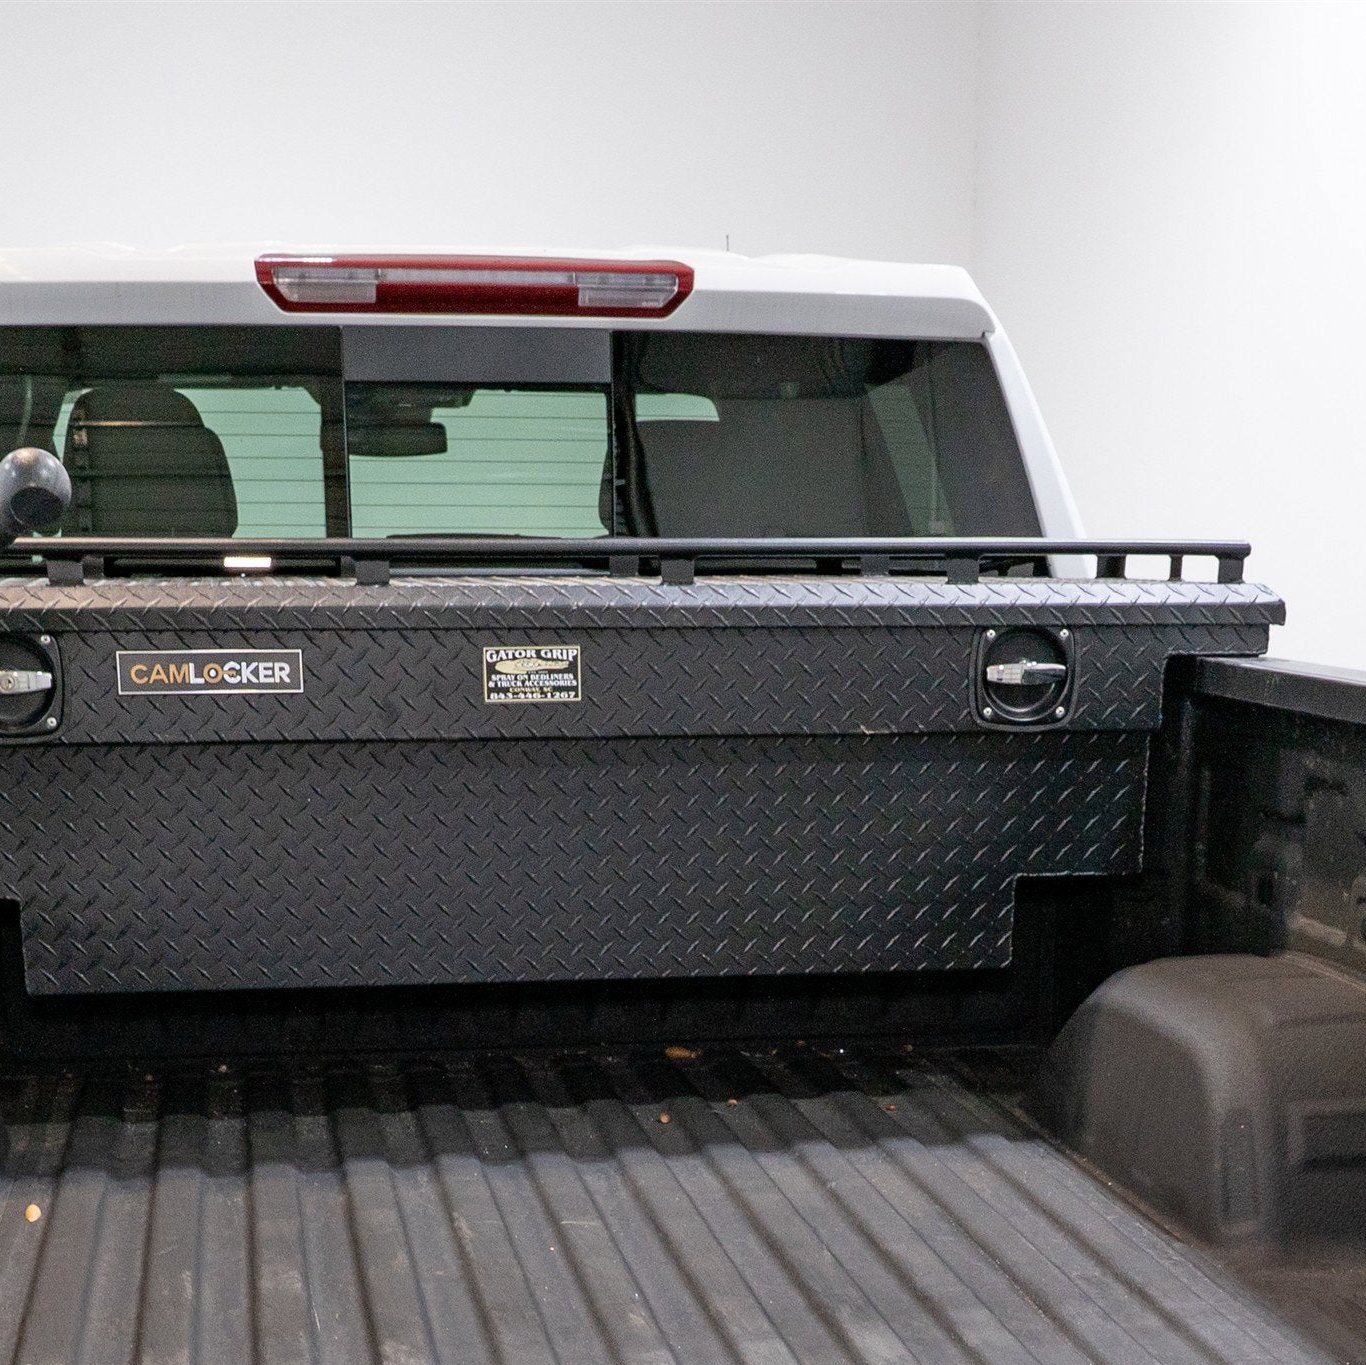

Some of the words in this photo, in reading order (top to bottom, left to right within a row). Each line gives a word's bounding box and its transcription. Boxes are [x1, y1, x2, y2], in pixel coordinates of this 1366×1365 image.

[486, 649, 537, 663] GATOR
[540, 649, 578, 661] GRIP
[130, 661, 291, 684] CAMLOCKER
[497, 680, 523, 688] TRUCK
